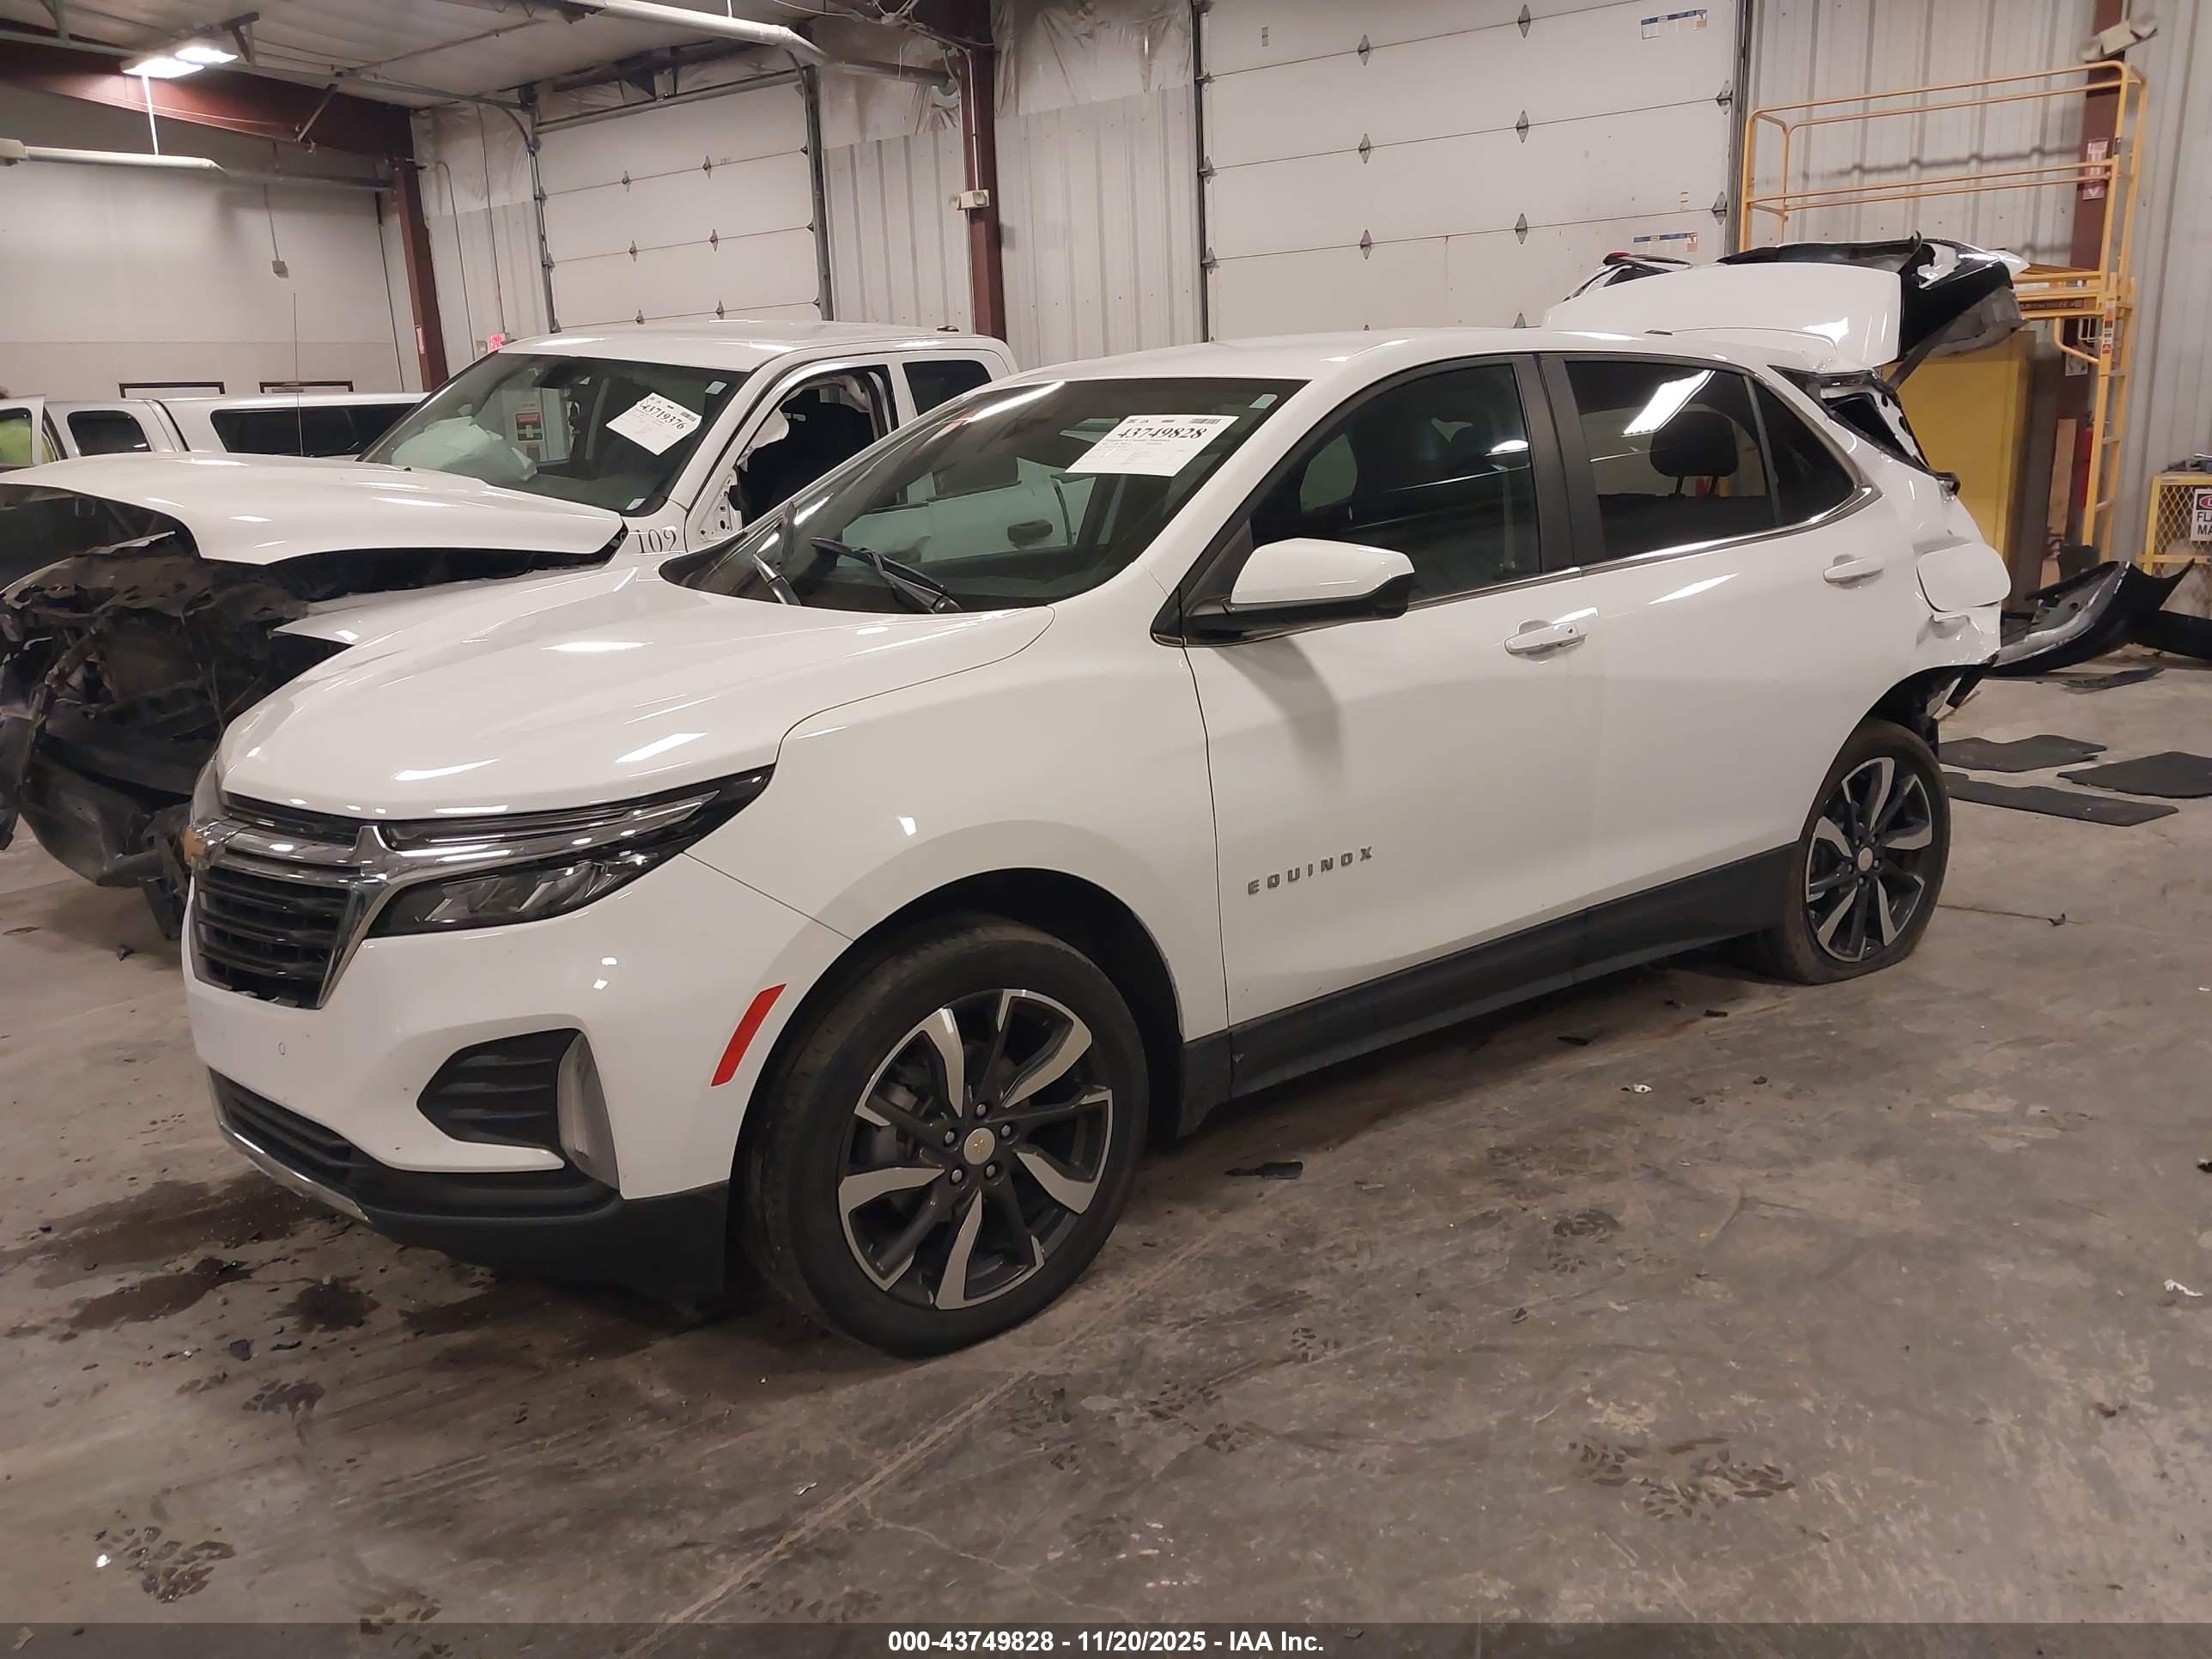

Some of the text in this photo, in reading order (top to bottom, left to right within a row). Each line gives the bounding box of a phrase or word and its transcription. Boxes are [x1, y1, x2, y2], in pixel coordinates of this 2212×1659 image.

[639, 404, 688, 430] 43719376
[1117, 427, 1208, 440] 43749828
[634, 528, 678, 554] 102
[1247, 846, 1373, 896] EQUINOX
